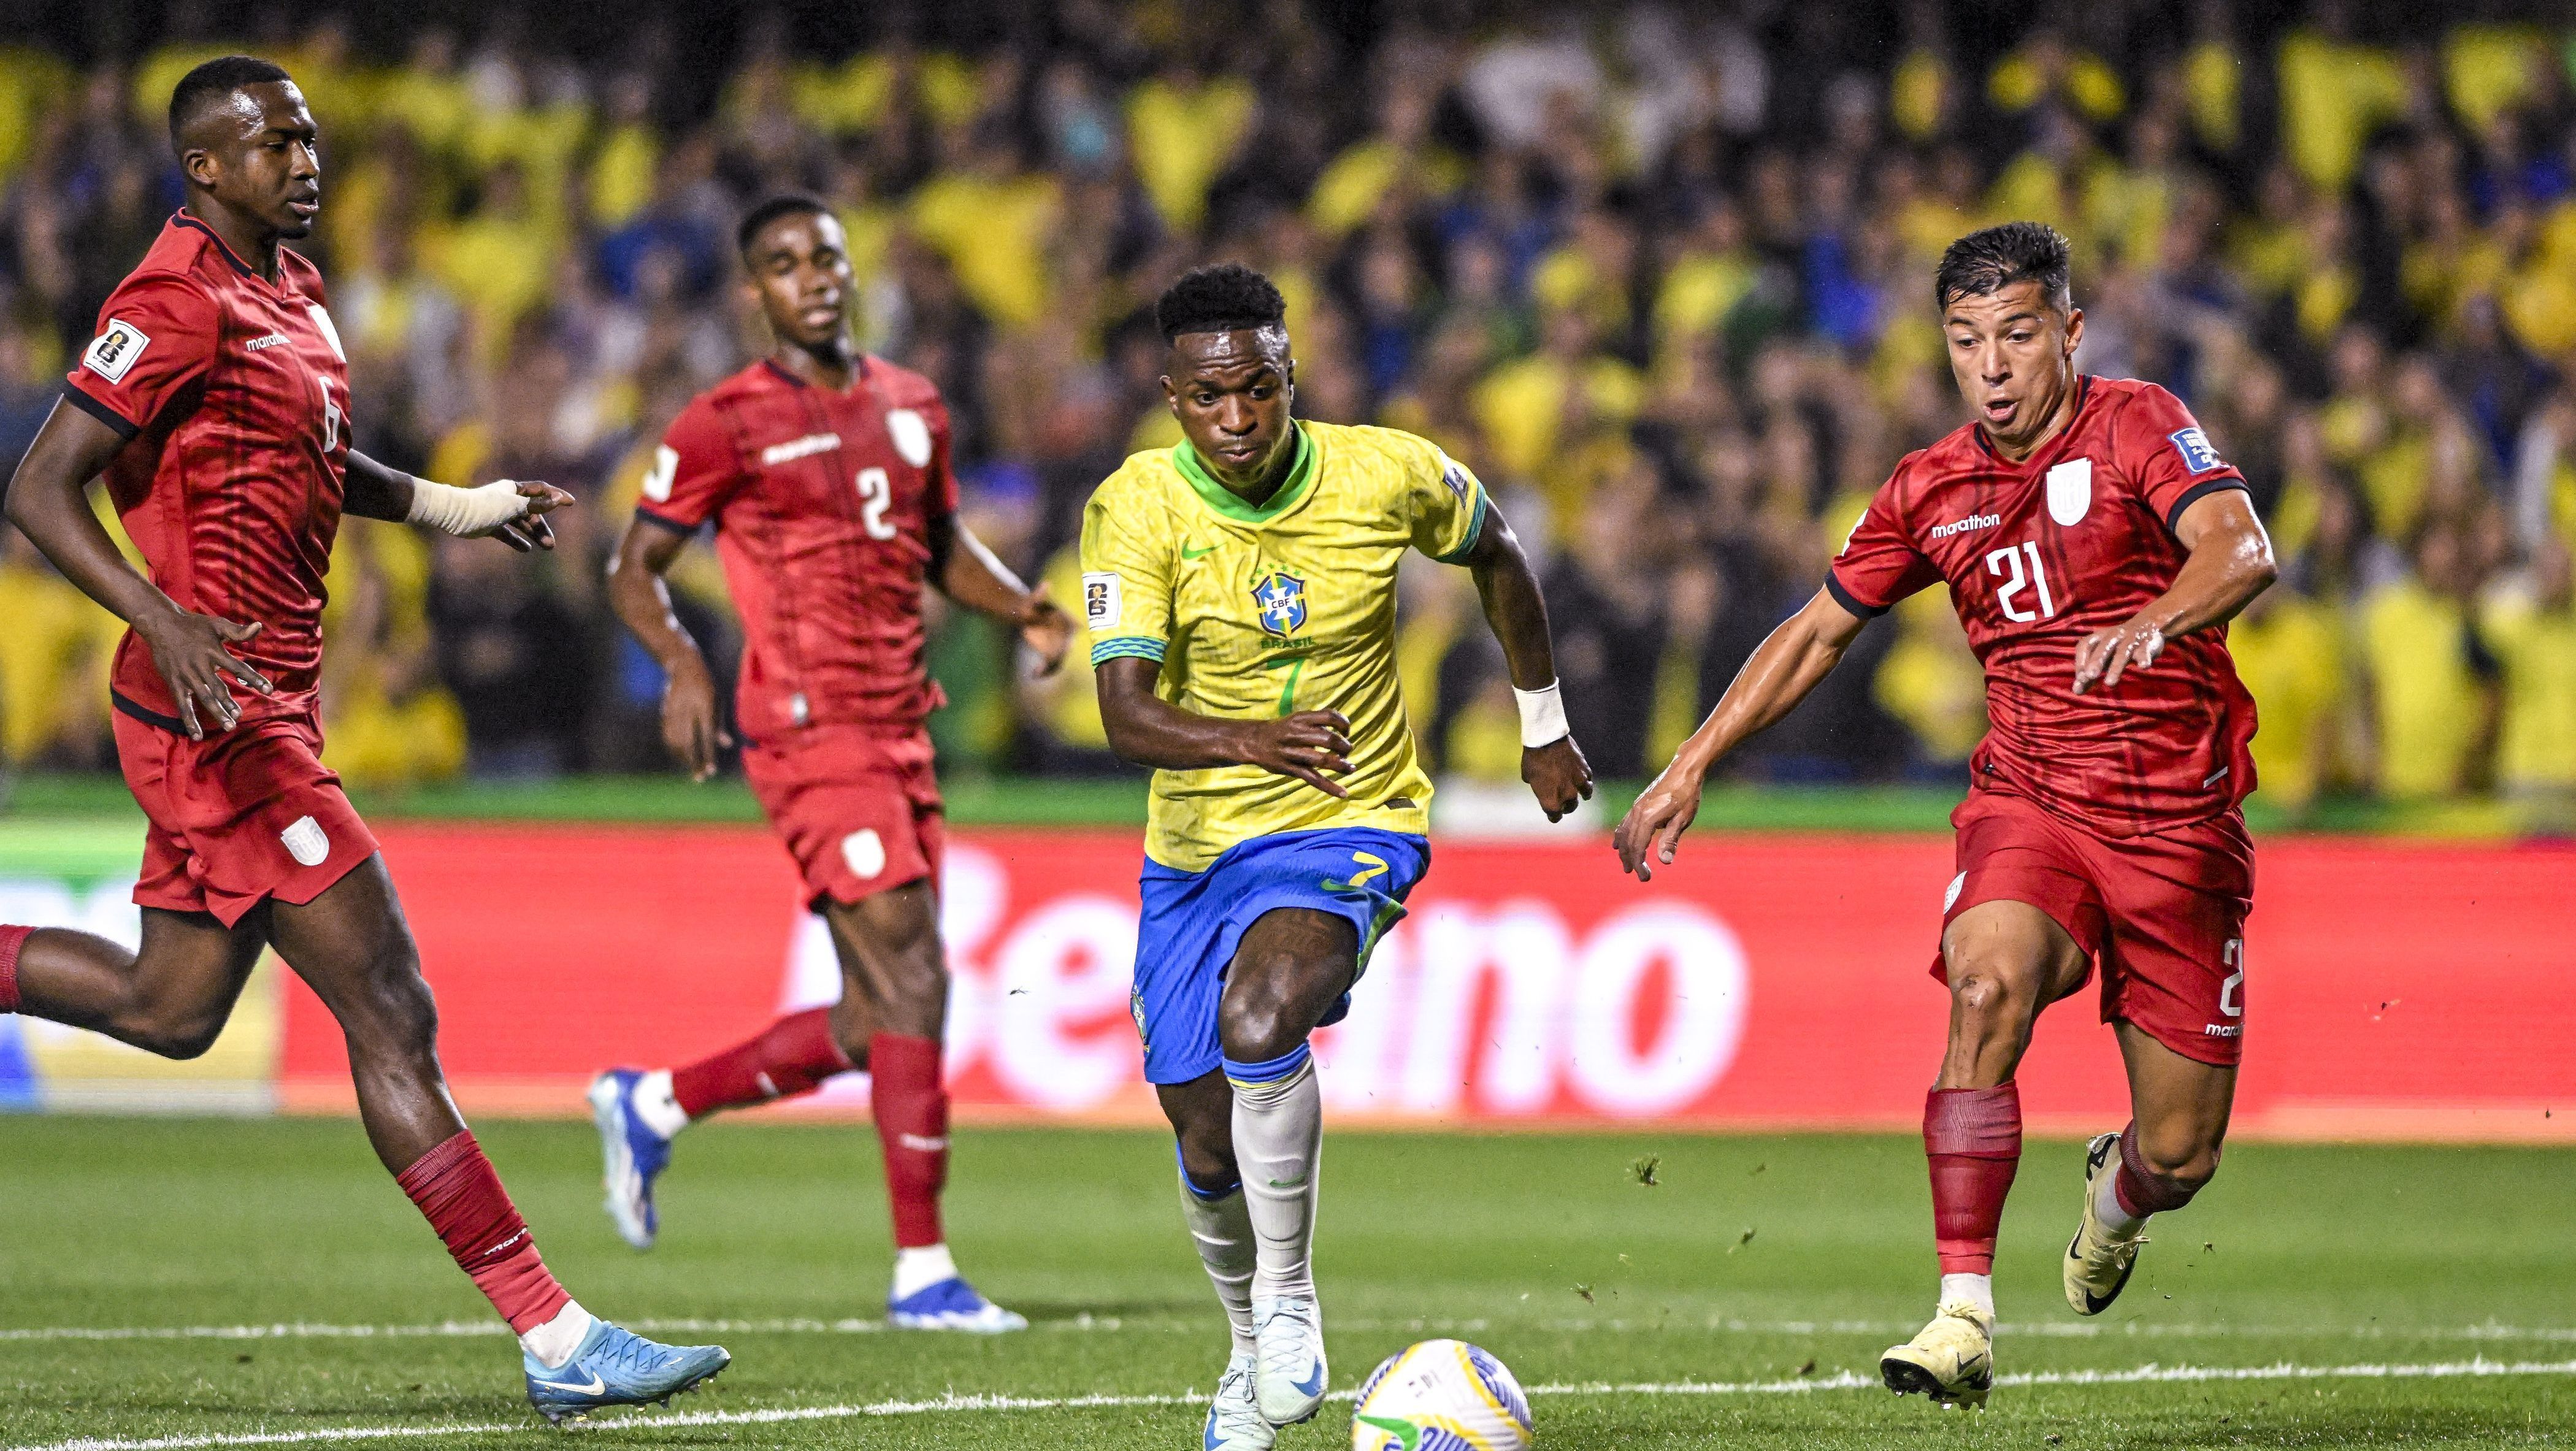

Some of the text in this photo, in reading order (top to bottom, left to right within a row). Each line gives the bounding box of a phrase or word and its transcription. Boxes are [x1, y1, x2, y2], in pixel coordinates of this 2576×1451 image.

[318, 376, 340, 453] 6
[857, 467, 897, 540] 2
[1932, 513, 2000, 538] marathon
[1271, 598, 1290, 609] CBF
[1985, 540, 2055, 623] 21
[1261, 636, 1314, 649] BRASIL
[1267, 657, 1306, 718] 7
[1349, 851, 1389, 887] 7
